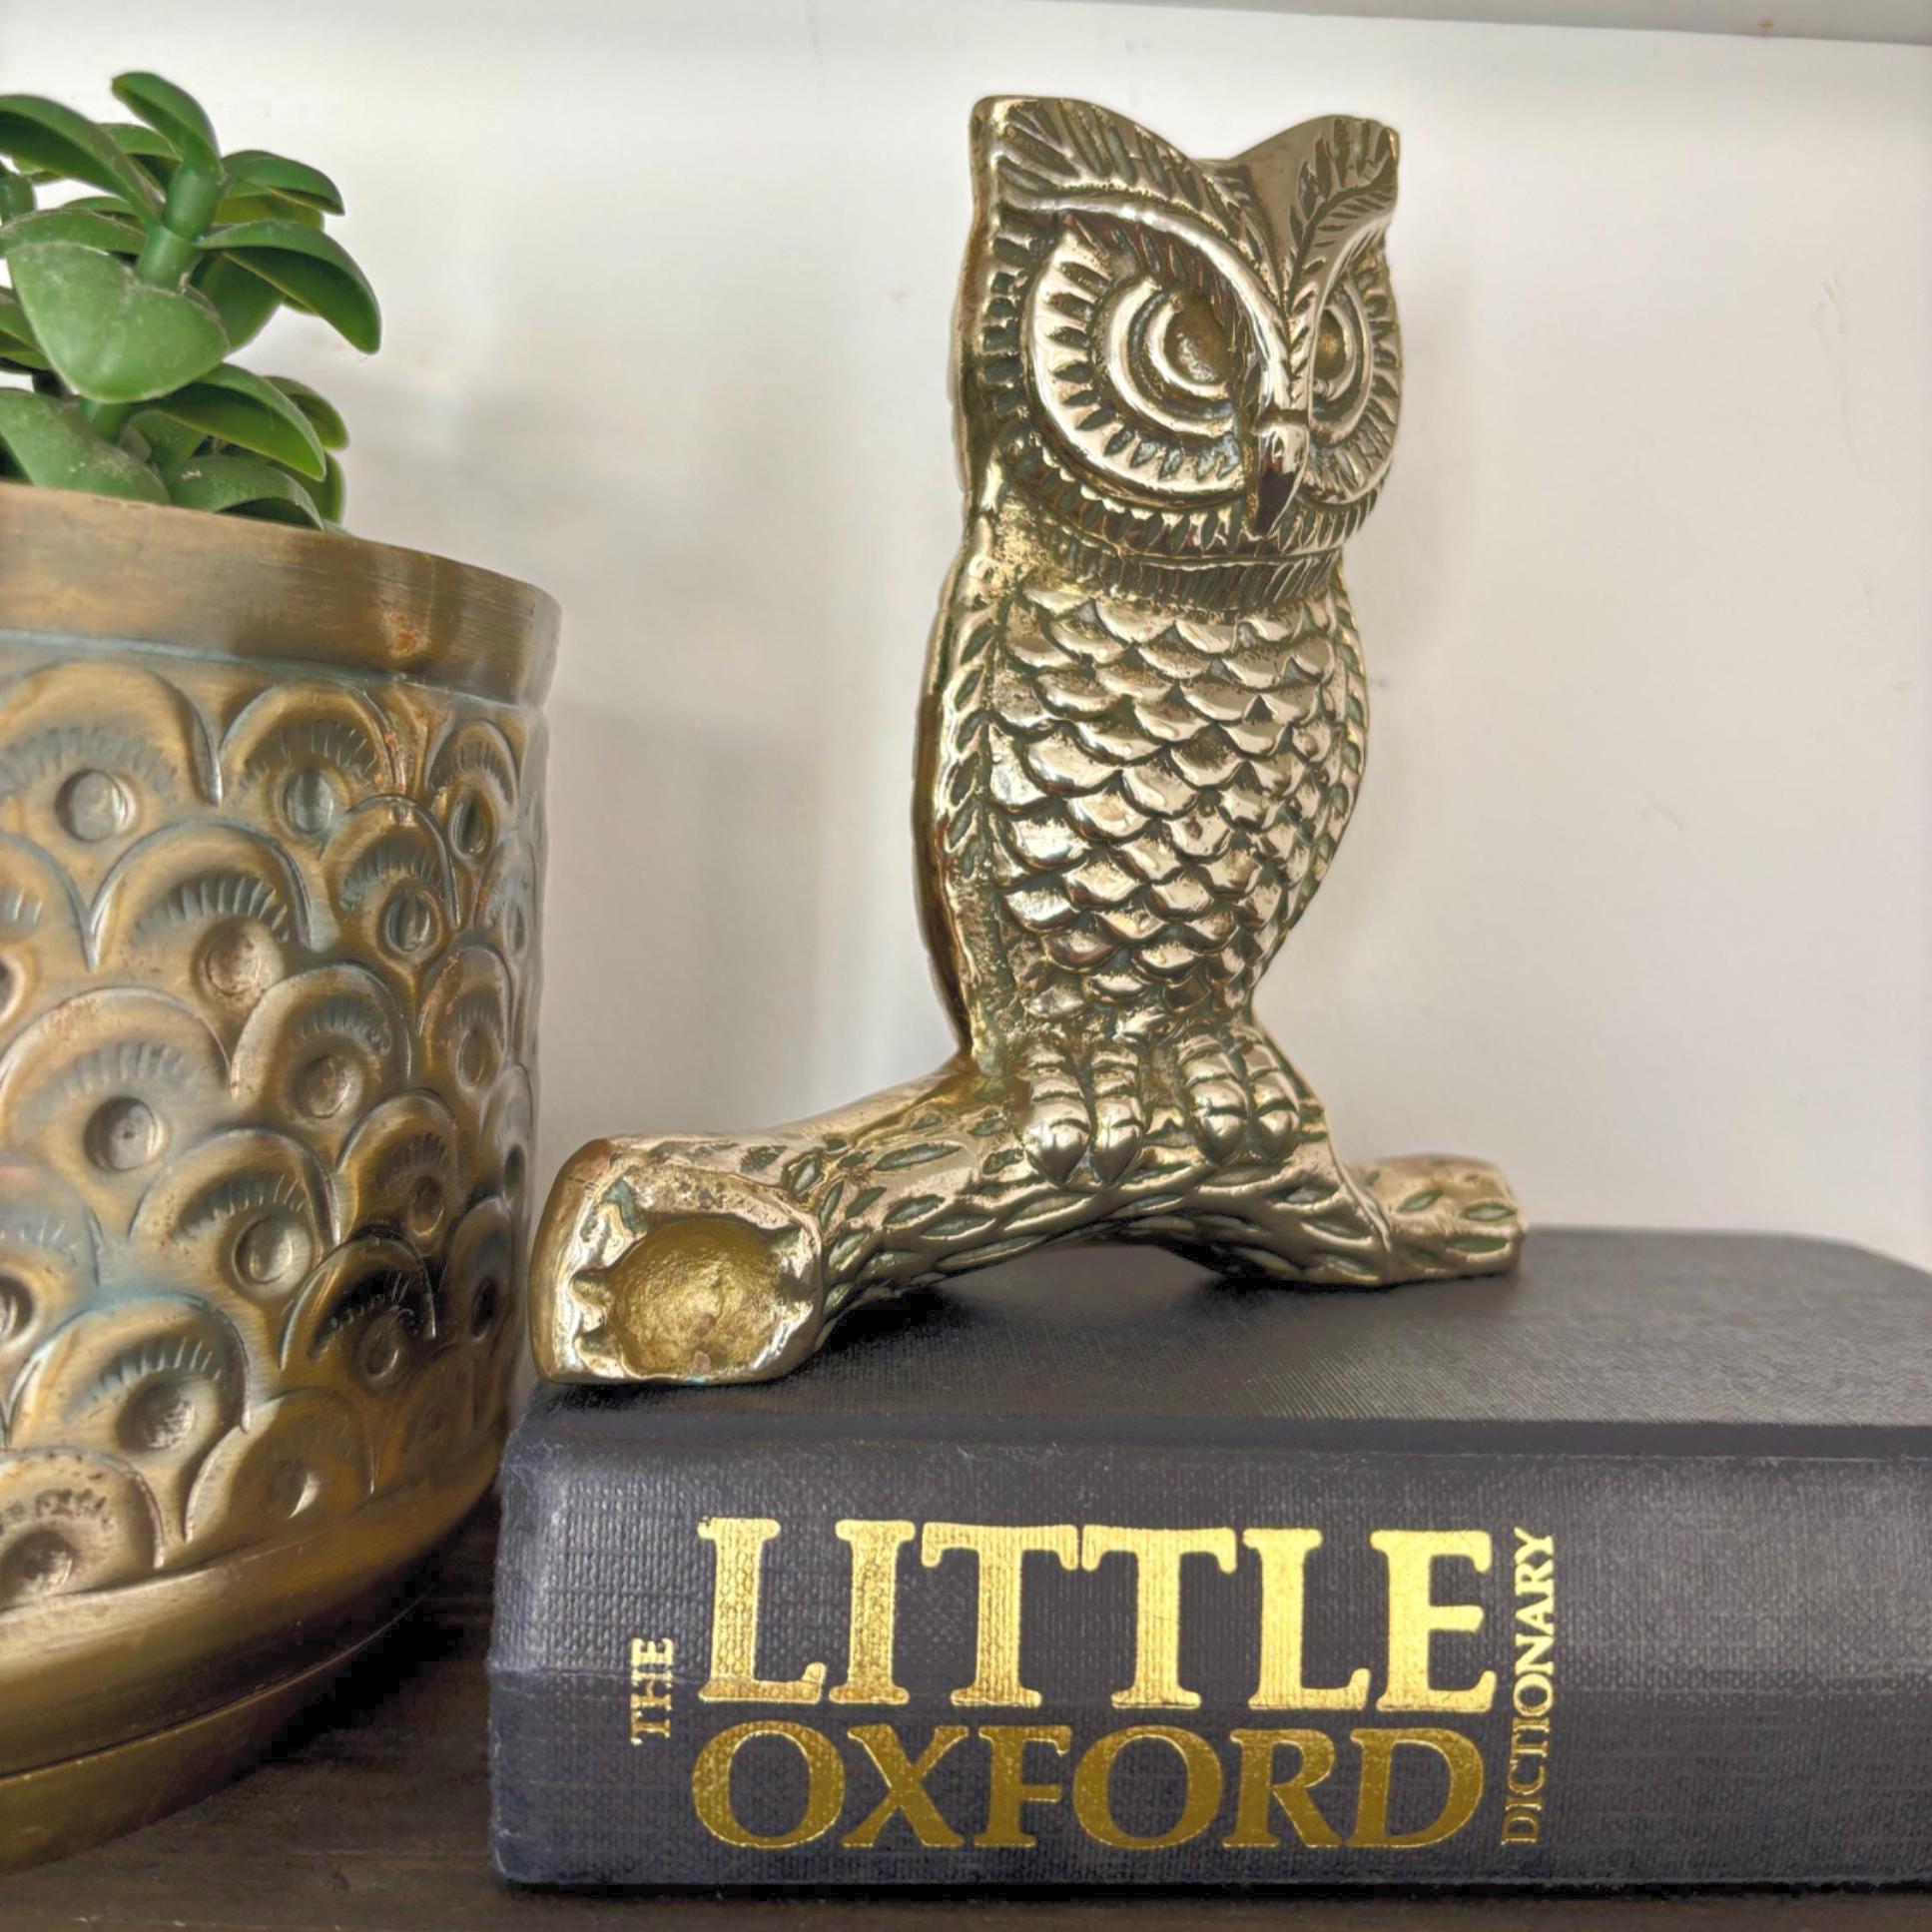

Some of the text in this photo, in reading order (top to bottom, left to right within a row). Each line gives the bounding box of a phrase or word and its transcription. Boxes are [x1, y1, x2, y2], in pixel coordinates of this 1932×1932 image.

[630, 1636, 676, 1745] THE
[697, 1517, 1498, 1714] LITTLE
[1501, 1527, 1557, 1846] DICTIONARY
[691, 1720, 1486, 1851] OXFORD
